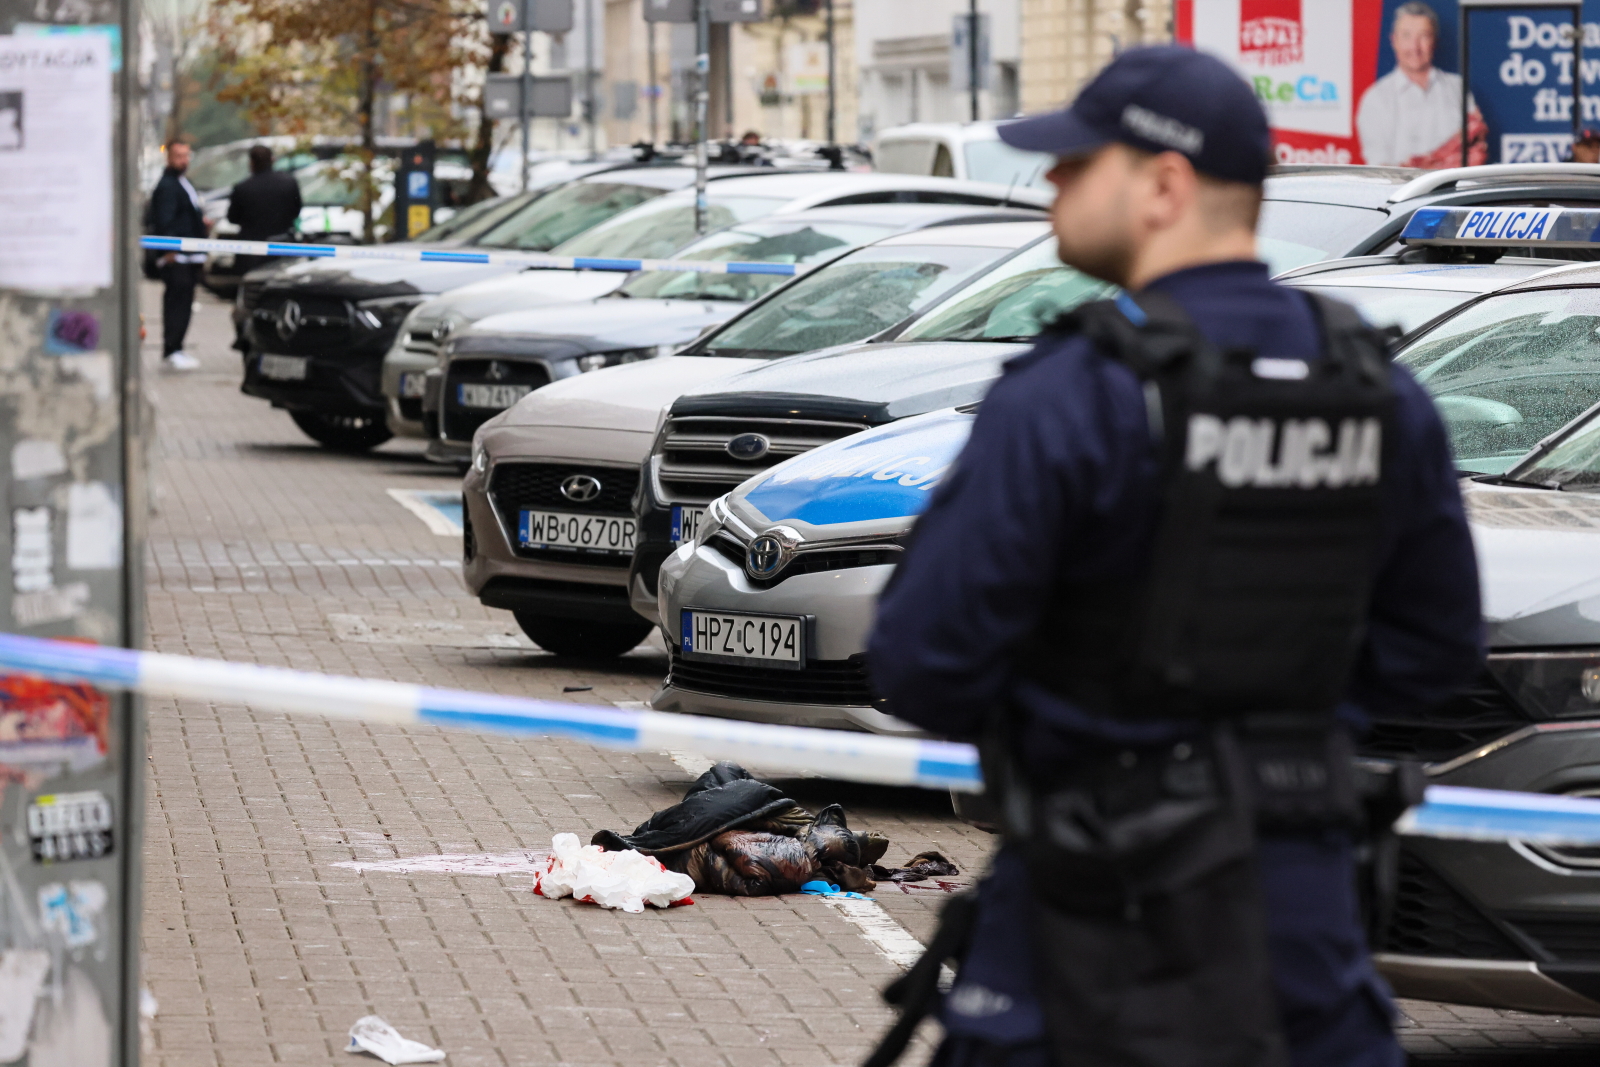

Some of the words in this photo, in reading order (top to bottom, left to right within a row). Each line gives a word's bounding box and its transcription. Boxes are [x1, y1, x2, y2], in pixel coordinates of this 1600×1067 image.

[1507, 15, 1600, 49] Dosa
[1500, 52, 1546, 86] do
[1461, 211, 1550, 240] POLICJA
[1186, 413, 1382, 488] POLICJA
[532, 514, 559, 542] WB
[567, 517, 635, 548] 0670R
[684, 636, 692, 646] PL
[696, 616, 735, 653] HPZ
[743, 620, 795, 658] C194
